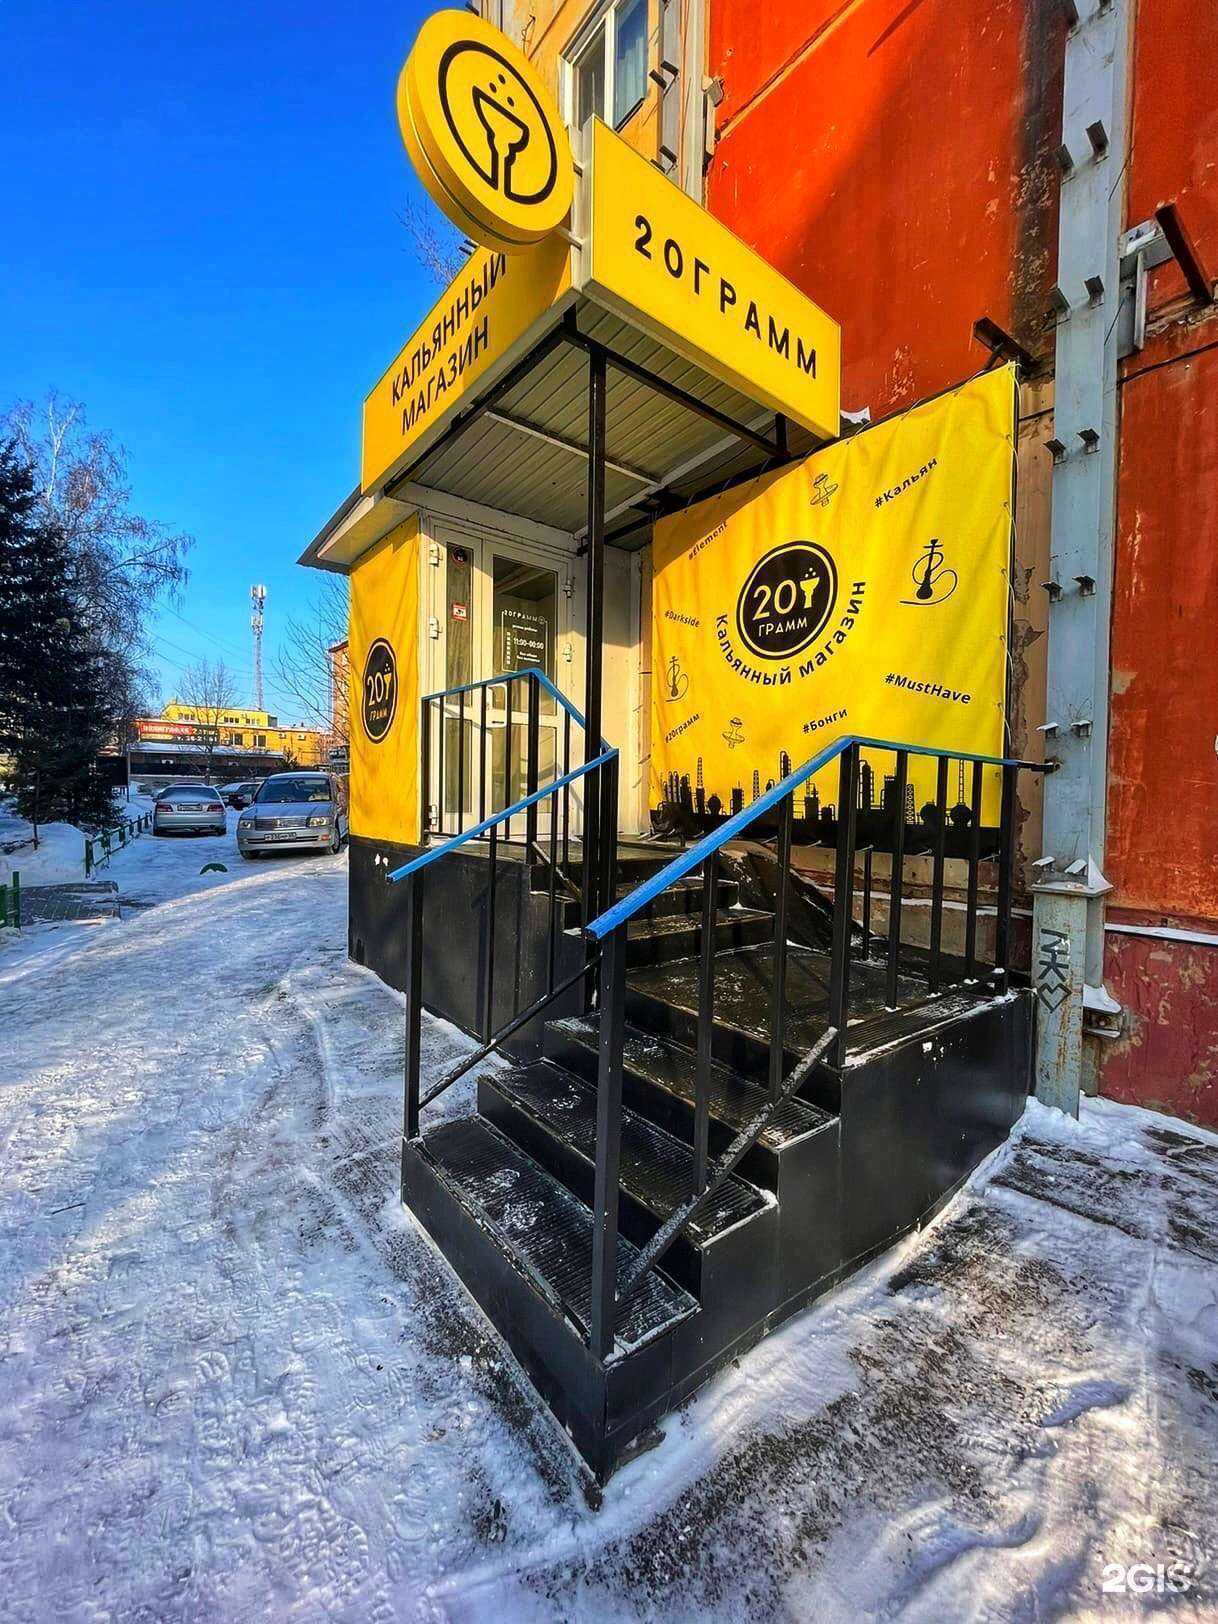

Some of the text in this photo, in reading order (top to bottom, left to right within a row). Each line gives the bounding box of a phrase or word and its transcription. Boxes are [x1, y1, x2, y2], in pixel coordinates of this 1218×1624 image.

[402, 315, 489, 436] МАГАЗИН
[874, 458, 938, 508] #Кальян
[752, 579, 797, 621] 20
[716, 581, 866, 686] Кальянный магазин
[758, 616, 808, 637] ГРАММ
[366, 671, 385, 706] 20
[885, 672, 972, 705] #MustHave
[802, 708, 849, 734] #Бонги
